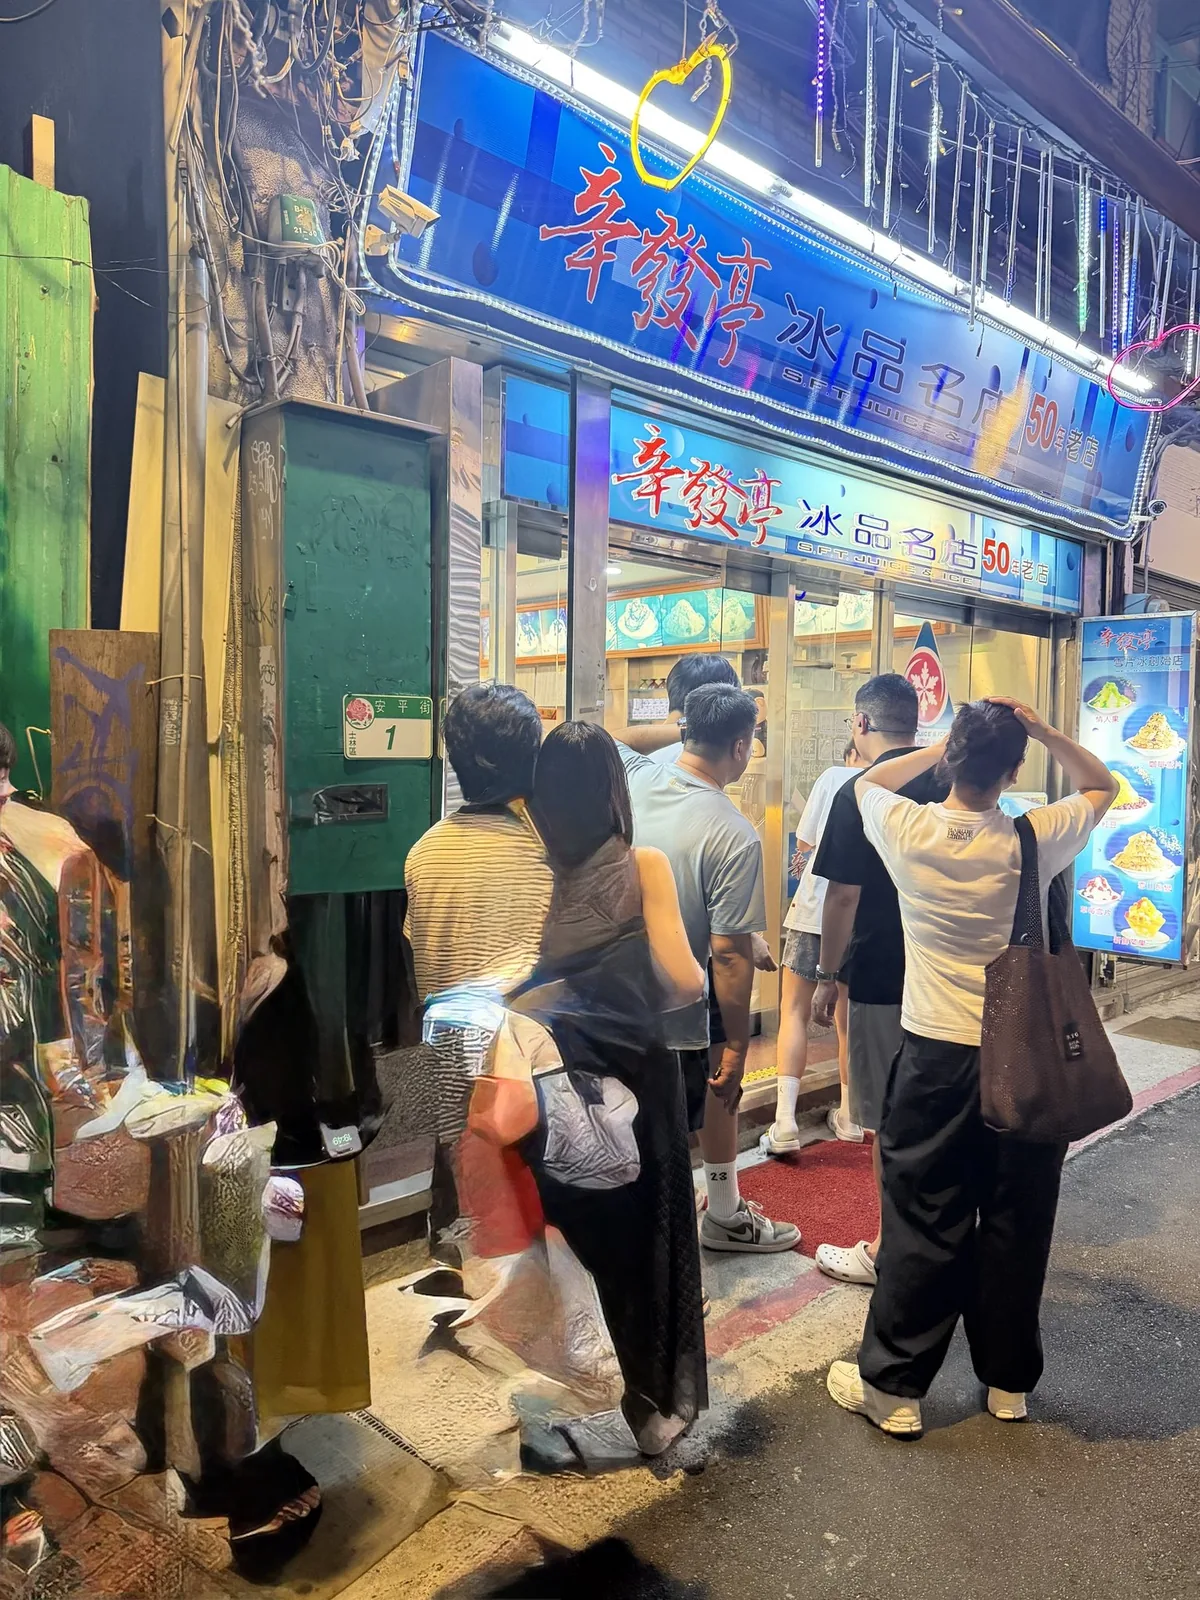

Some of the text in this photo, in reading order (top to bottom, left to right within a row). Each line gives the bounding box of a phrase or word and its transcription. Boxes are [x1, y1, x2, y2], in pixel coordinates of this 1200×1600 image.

[540, 143, 772, 367] 辛發亭
[858, 400, 937, 435] JUICE
[612, 423, 783, 546] 辛發亭
[797, 499, 978, 572] 冰品名店
[853, 555, 916, 575] JUICE
[943, 572, 973, 585] ICE
[374, 699, 430, 714] 安平街
[348, 731, 356, 755] 士林區
[385, 724, 396, 750] 1
[710, 1172, 728, 1181] 23
